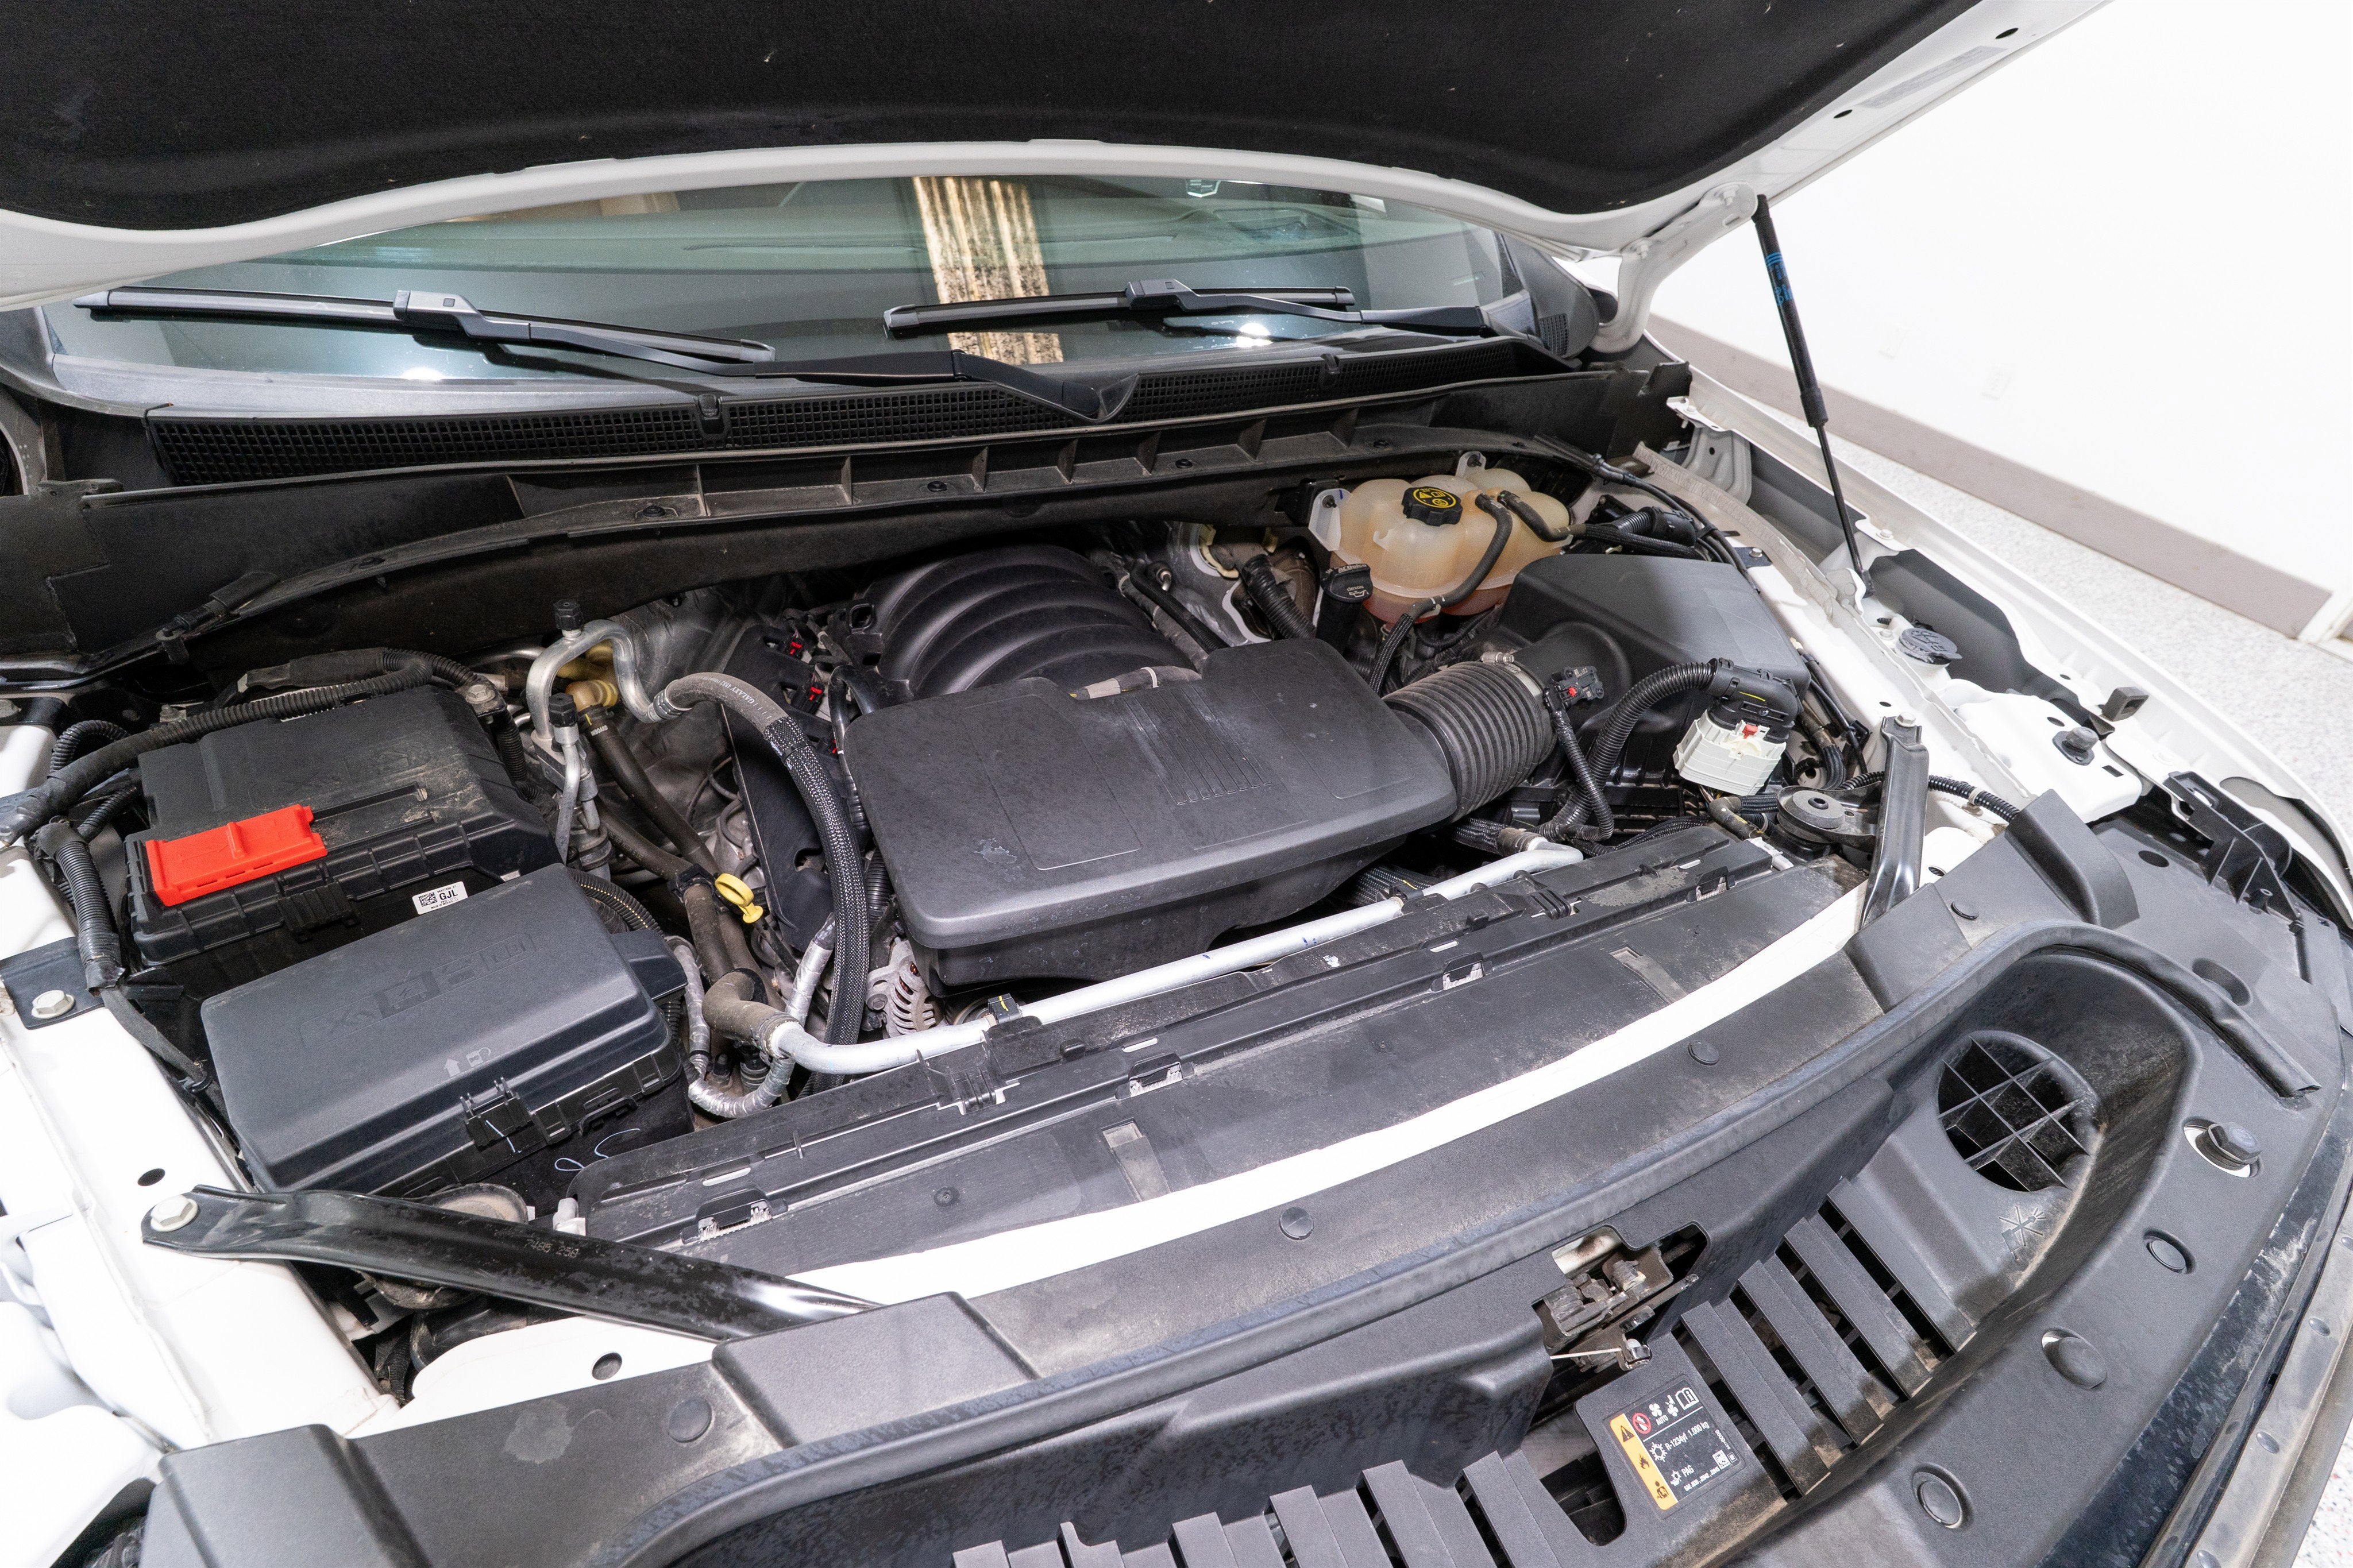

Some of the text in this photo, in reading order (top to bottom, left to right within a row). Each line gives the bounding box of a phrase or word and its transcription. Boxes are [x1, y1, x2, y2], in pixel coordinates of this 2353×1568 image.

[1338, 564, 1367, 573] ACDelco
[730, 686, 755, 704] GALAXY
[591, 725, 608, 736] INBOARD
[439, 890, 458, 901] GJL
[1656, 1415, 1669, 1426] AUTO
[1665, 1421, 1710, 1451] R-1234yf 1.000 kg
[1681, 1465, 1695, 1477] PAG
